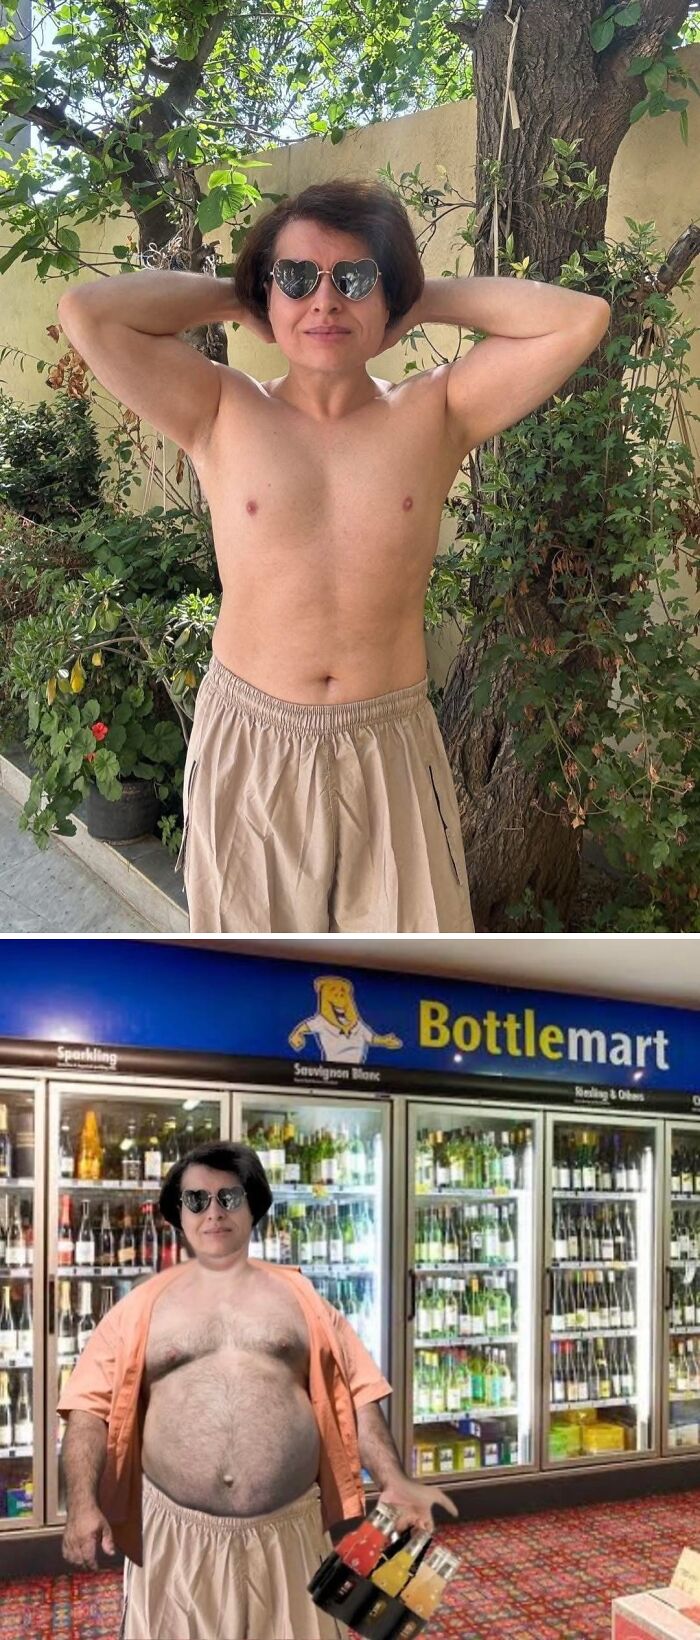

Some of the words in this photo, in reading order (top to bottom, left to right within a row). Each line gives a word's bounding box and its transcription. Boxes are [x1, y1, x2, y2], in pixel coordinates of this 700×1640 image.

[419, 1000, 670, 1071] Bottlemart
[57, 1046, 117, 1065] Sparkling
[294, 1063, 349, 1080] Sauvignon
[352, 1068, 380, 1081] Blanc
[610, 1089, 616, 1100] &
[618, 1089, 644, 1102] Others
